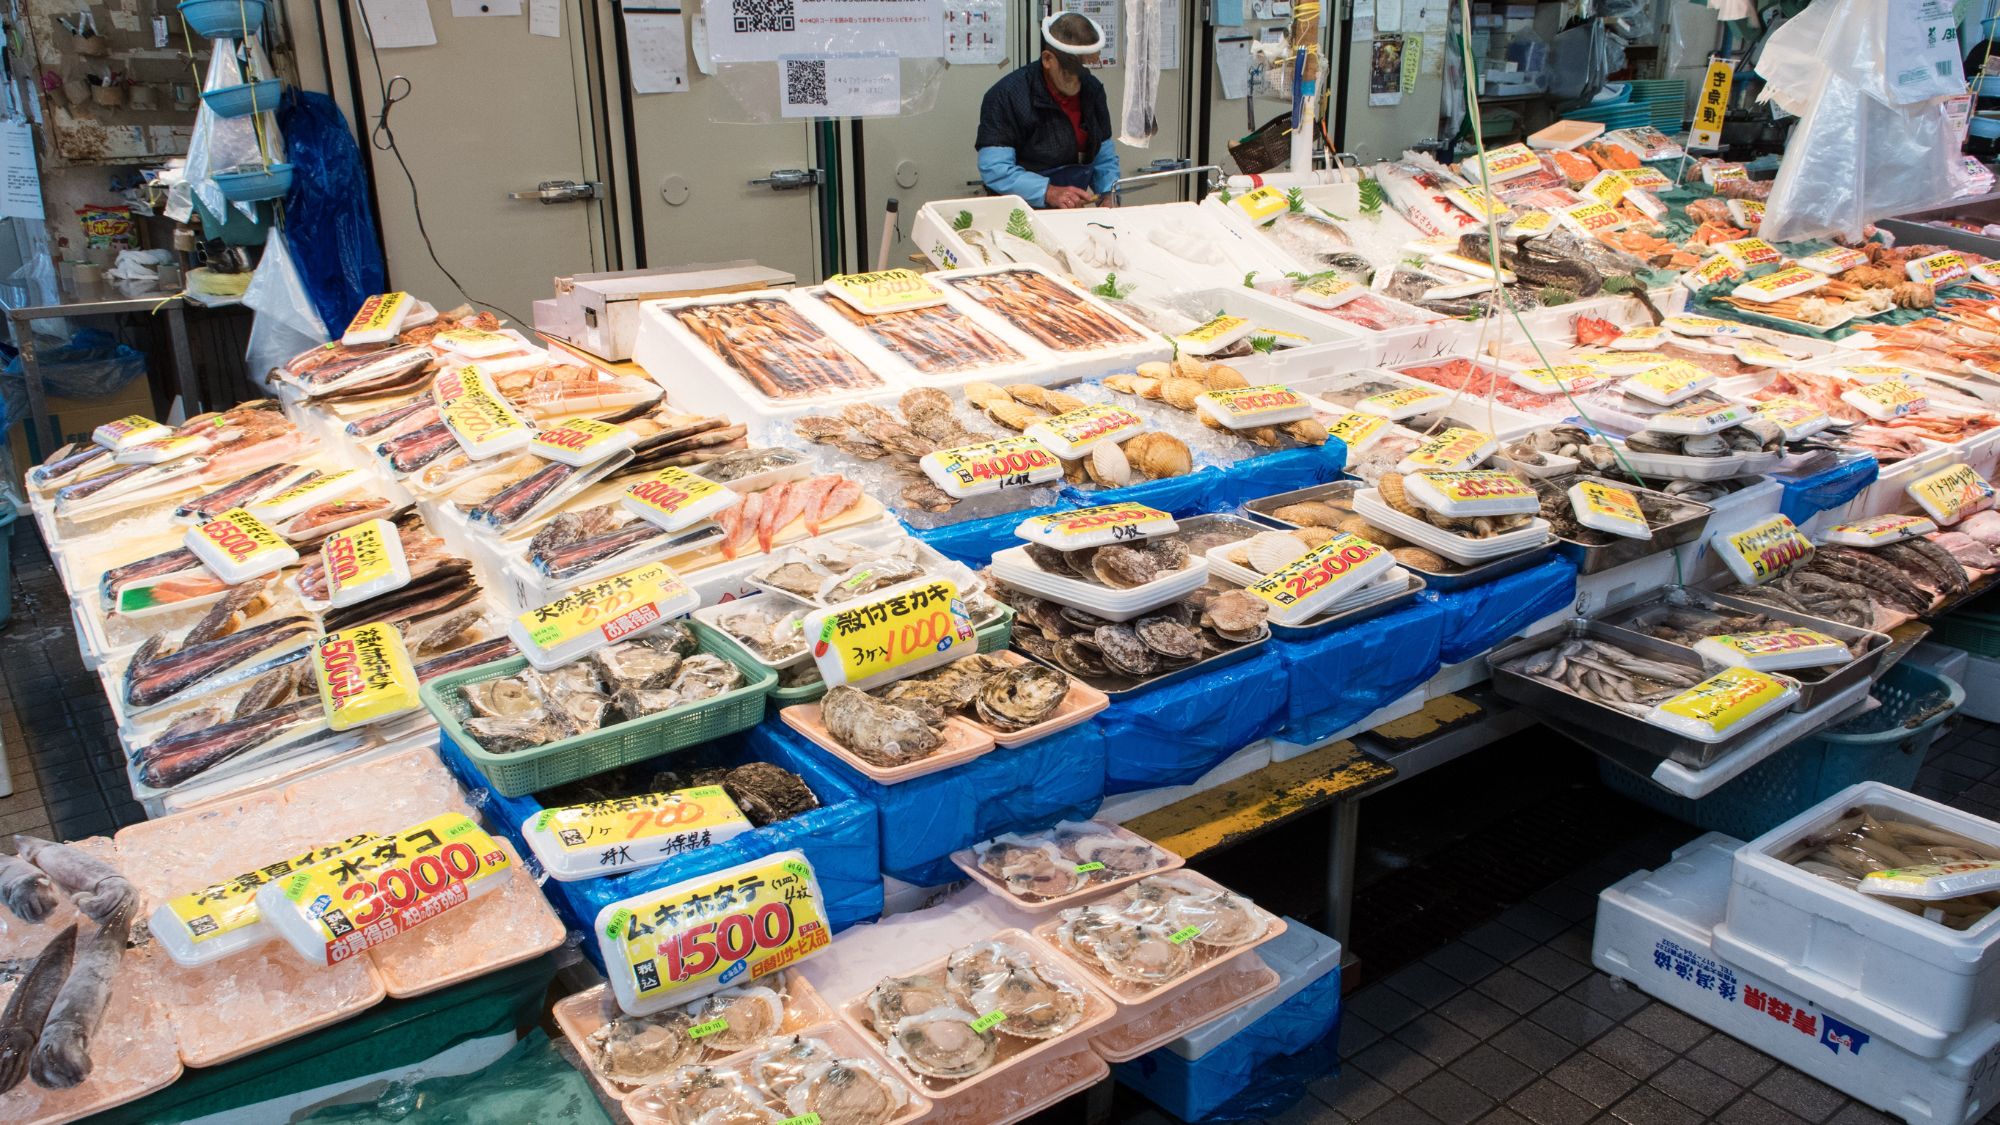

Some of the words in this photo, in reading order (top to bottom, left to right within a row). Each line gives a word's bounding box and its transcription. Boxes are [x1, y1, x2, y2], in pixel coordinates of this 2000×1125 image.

[602, 603, 661, 640] お買得品
[835, 584, 949, 637] 殻付きカキ
[329, 828, 443, 886] 水ダコ
[627, 875, 765, 941] ムキホタテ
[785, 884, 813, 904] 4枚
[330, 916, 399, 962] お買得品
[751, 929, 830, 978] 日替りサービス品
[636, 962, 658, 990] 税込
[1653, 948, 1738, 1002] 後潟漁協
[1717, 964, 1734, 976] TEL
[1743, 984, 1818, 1037] 青森県
